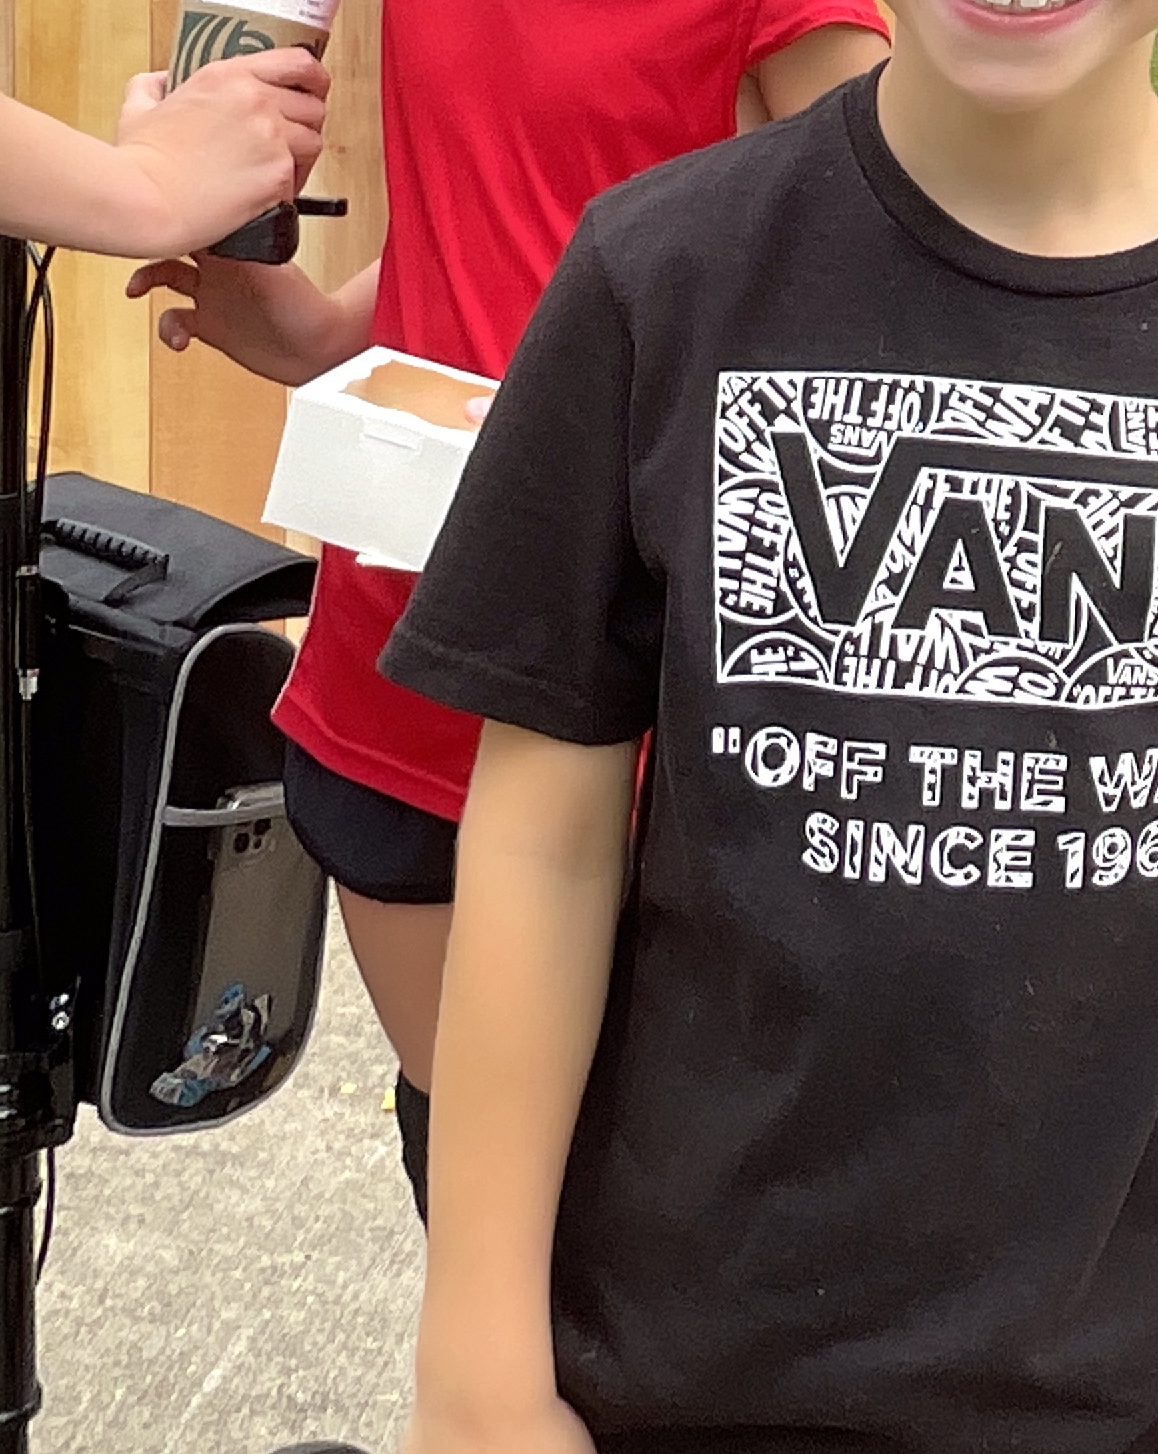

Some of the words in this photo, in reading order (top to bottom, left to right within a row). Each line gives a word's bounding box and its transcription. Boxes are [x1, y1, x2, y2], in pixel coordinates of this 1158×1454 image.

[711, 724, 888, 801] "OFF
[908, 744, 1068, 814] THE
[801, 810, 1037, 889] SINCE
